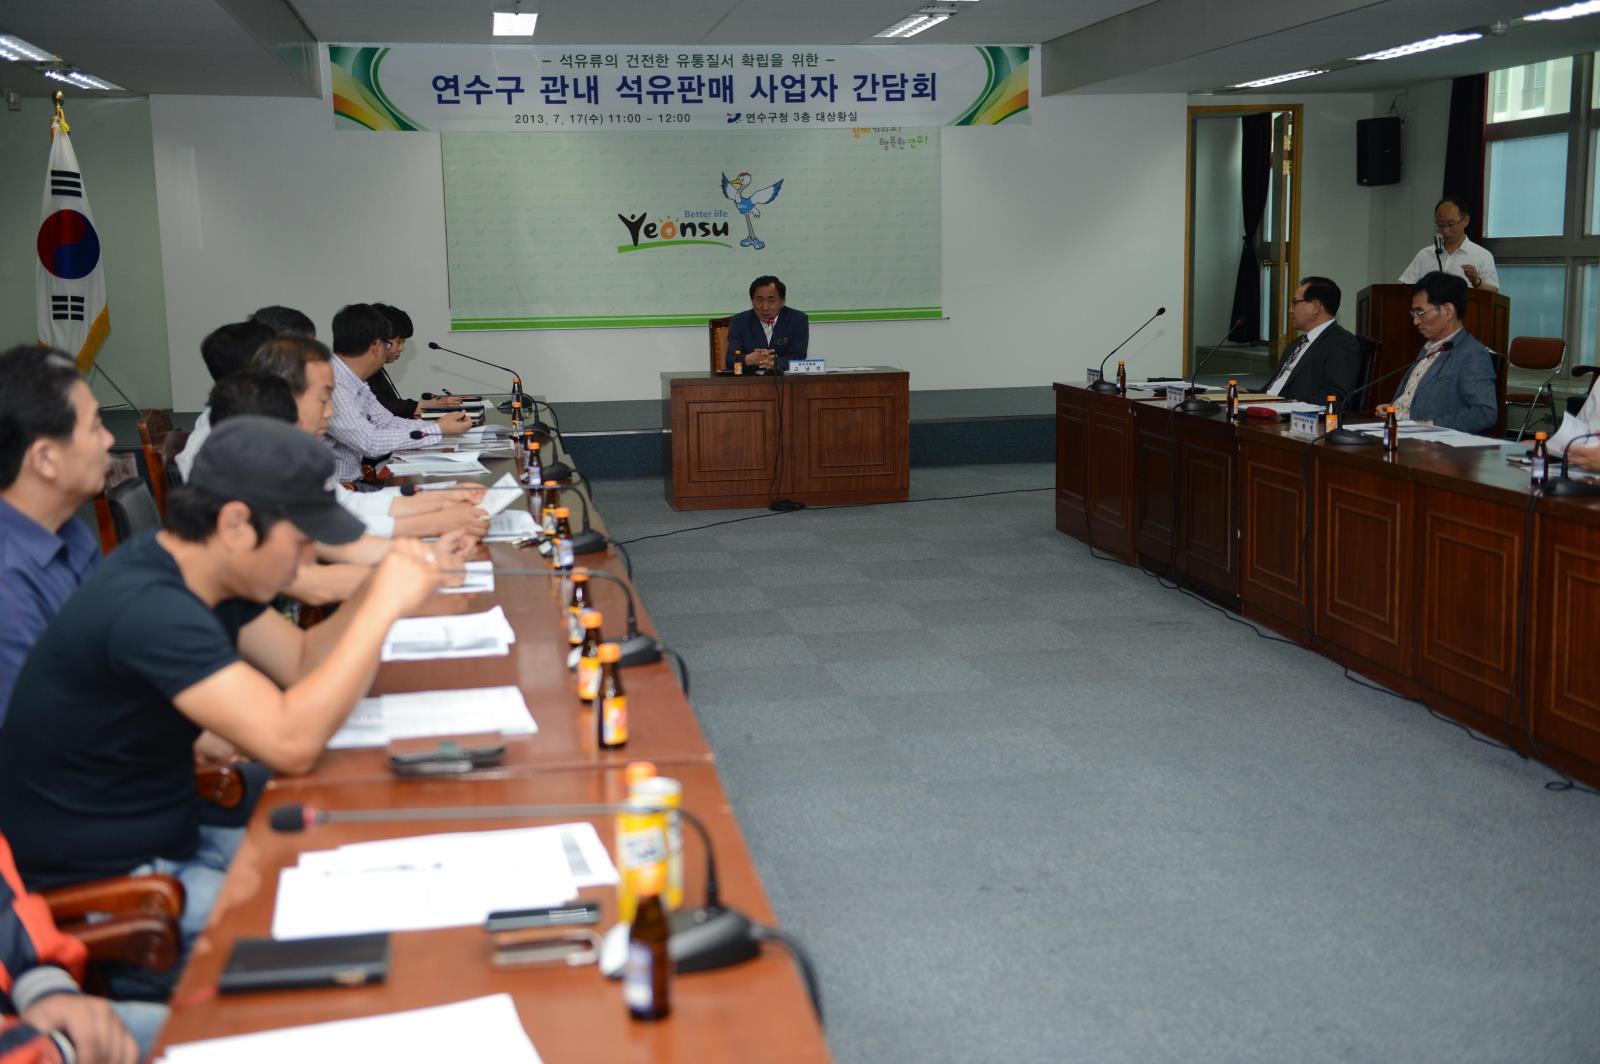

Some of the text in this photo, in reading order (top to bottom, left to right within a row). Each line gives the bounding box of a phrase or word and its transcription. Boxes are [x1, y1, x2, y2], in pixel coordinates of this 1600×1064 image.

[559, 53, 619, 69] 석유류의
[626, 53, 670, 69] 건전한
[676, 53, 735, 69] 유통질서
[741, 53, 784, 68] 확립을
[791, 52, 820, 68] 위한
[431, 72, 937, 105] 연수구 관내 석유판매 사업자 간담회
[569, 113, 604, 126] 17(수)
[608, 113, 641, 124] 11:00
[658, 113, 691, 123] 12:00
[745, 110, 858, 124] 연수구청 3층 대상황실
[684, 209, 729, 218] Better life
[617, 212, 729, 247] Yeonsu
